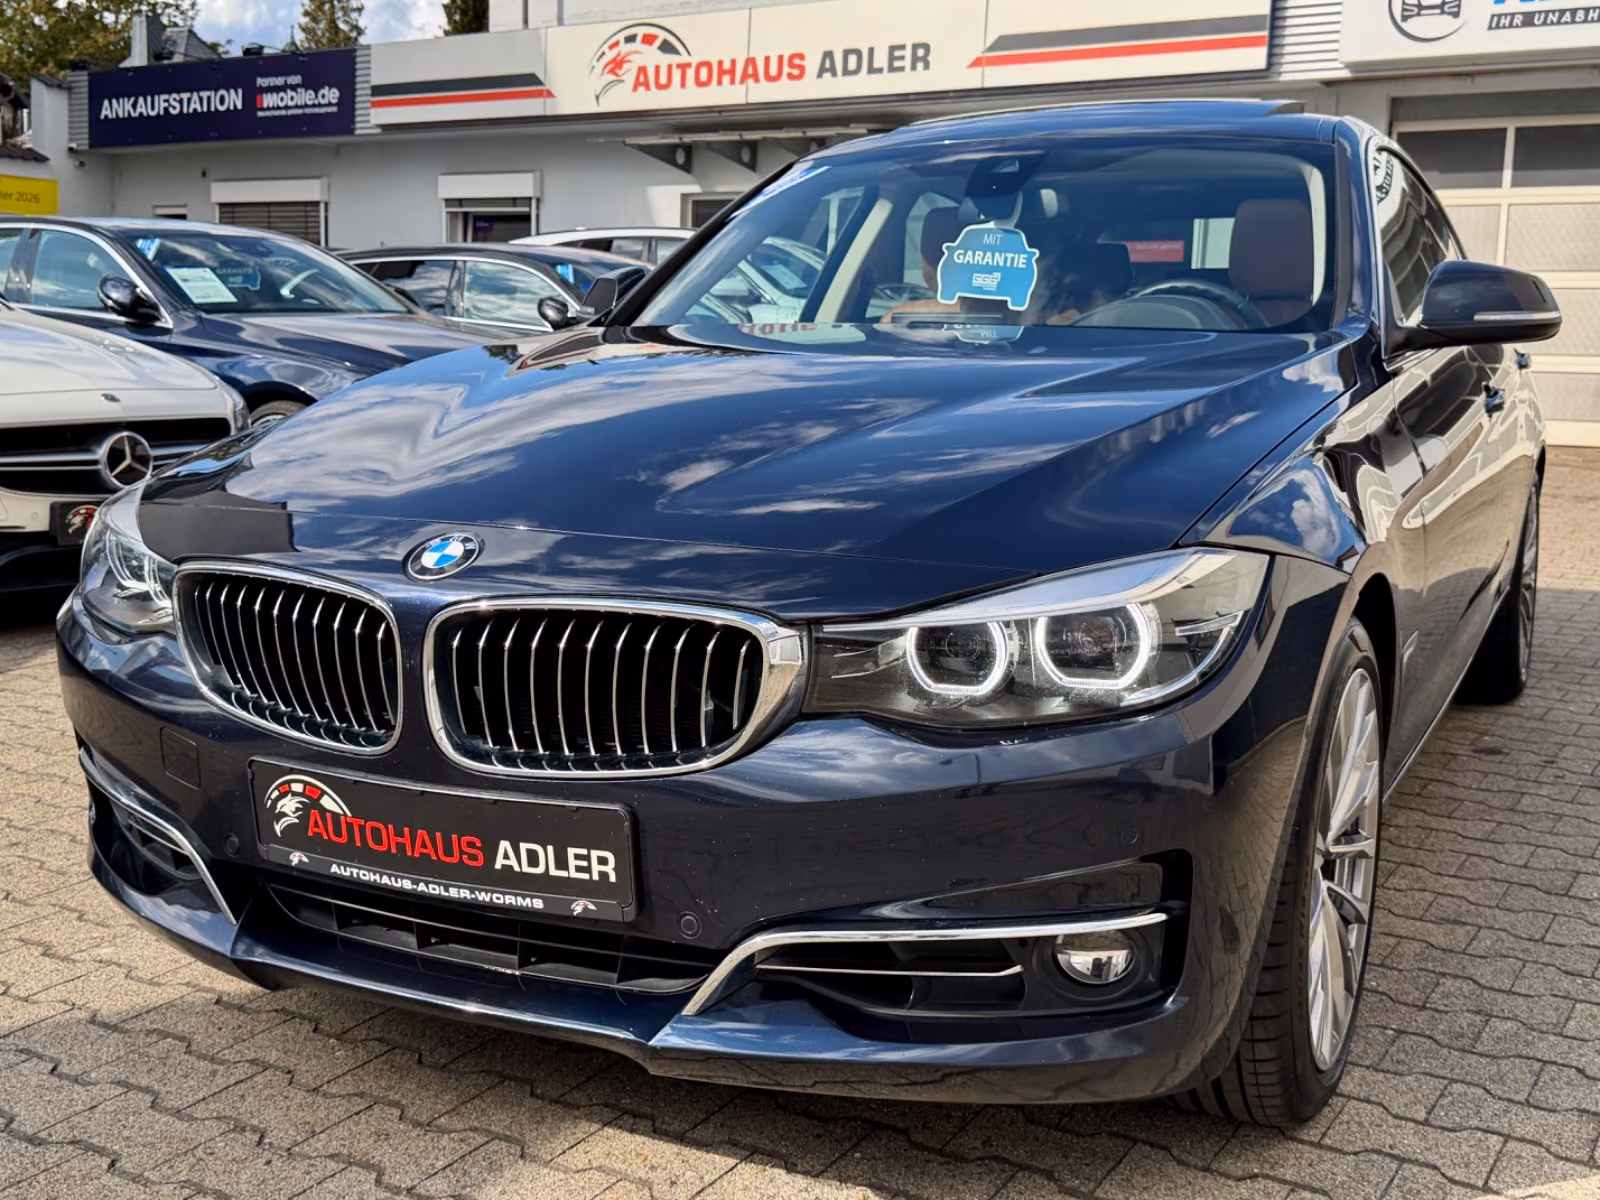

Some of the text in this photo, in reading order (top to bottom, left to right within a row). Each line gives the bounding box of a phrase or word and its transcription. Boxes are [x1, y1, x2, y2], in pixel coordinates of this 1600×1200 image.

[1491, 8, 1600, 28] IHR UNABH
[632, 43, 931, 92] AUTOHAUS ADLER
[100, 88, 243, 120] ANKAUFSTATION
[262, 86, 340, 109] mobile.de
[16, 190, 40, 205] 2026
[983, 233, 1003, 245] MIT
[953, 249, 1028, 269] GARANTIE
[307, 809, 617, 883] AUTOHAUS ADLER
[330, 863, 544, 909] AUTOHAUS-ADLER-WORMS
